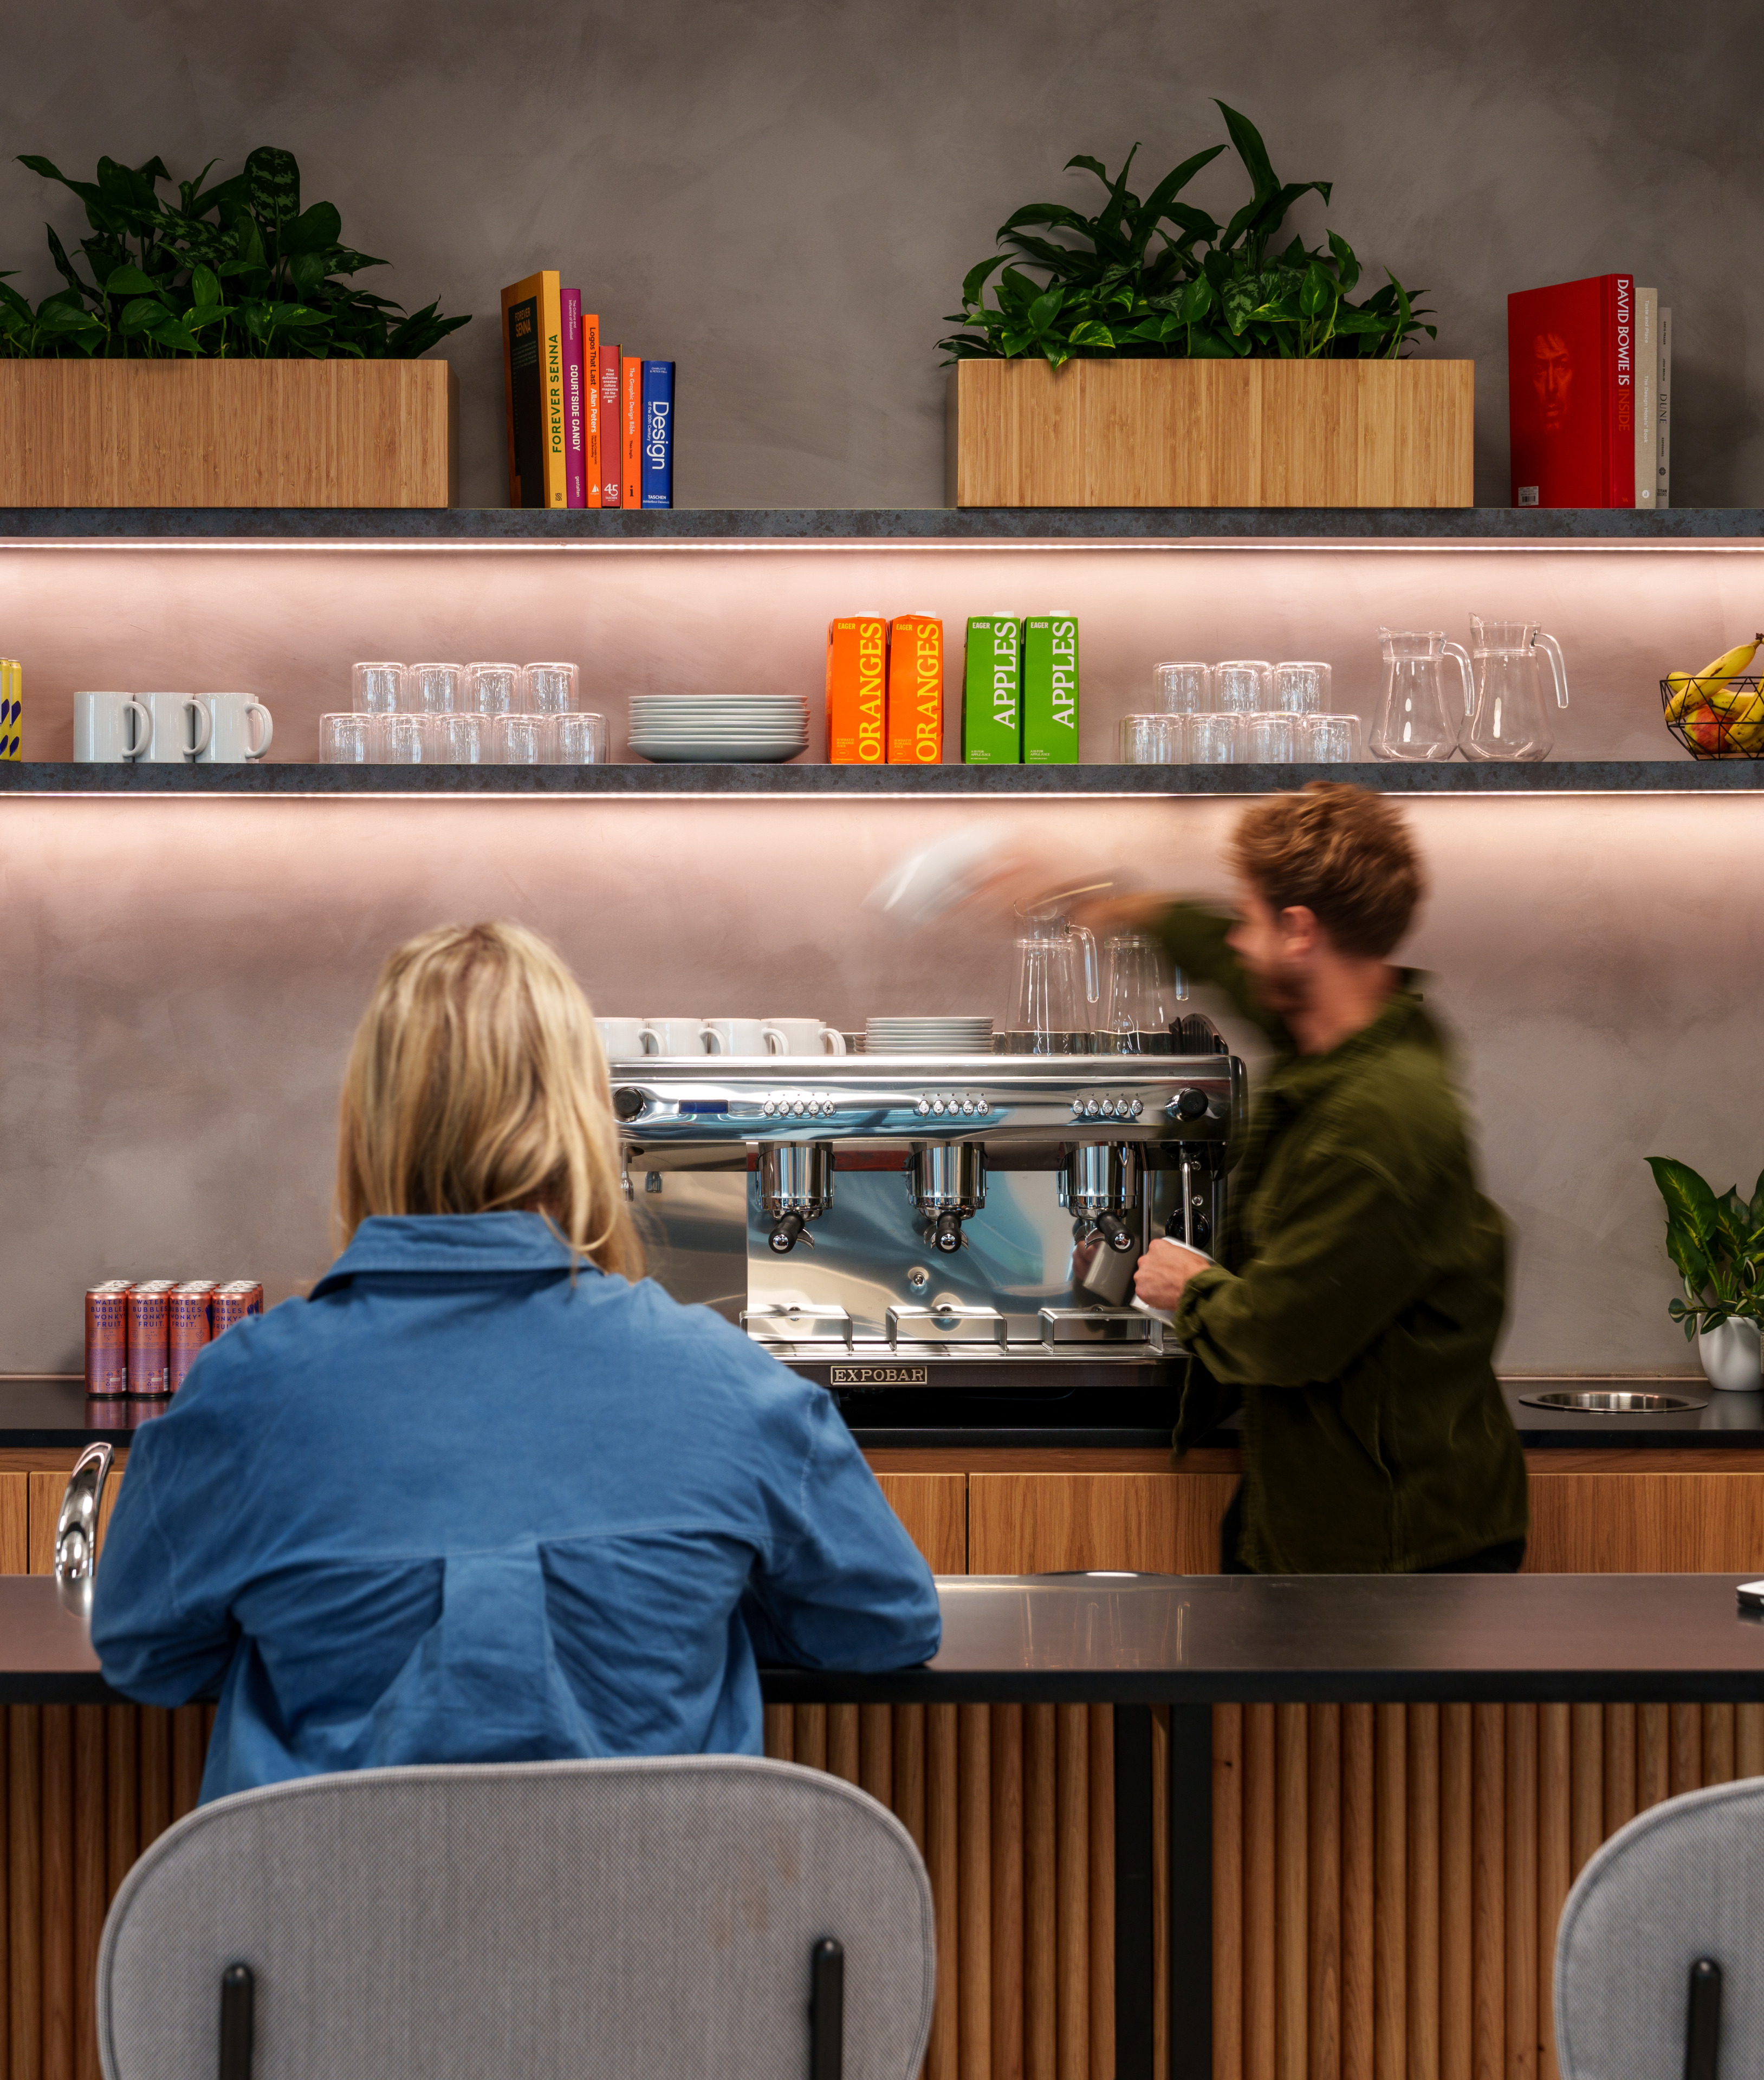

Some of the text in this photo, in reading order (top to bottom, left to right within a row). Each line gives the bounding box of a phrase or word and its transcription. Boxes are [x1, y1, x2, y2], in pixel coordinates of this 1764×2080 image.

[515, 307, 530, 322] FOREVER
[516, 319, 531, 337] SENNA
[1618, 280, 1630, 431] DAVID BOWIE IS INSIDE
[549, 334, 561, 452] FOREVER SENNA
[570, 365, 580, 451] COURTSIDE CANDY
[646, 402, 669, 469] Design
[604, 483, 618, 496] 45
[859, 623, 881, 761] ORANGES
[916, 623, 939, 762] ORANGES
[993, 621, 1016, 730] APPLES
[1052, 621, 1075, 729] APPLES
[834, 1369, 923, 1381] EXPOBAR
